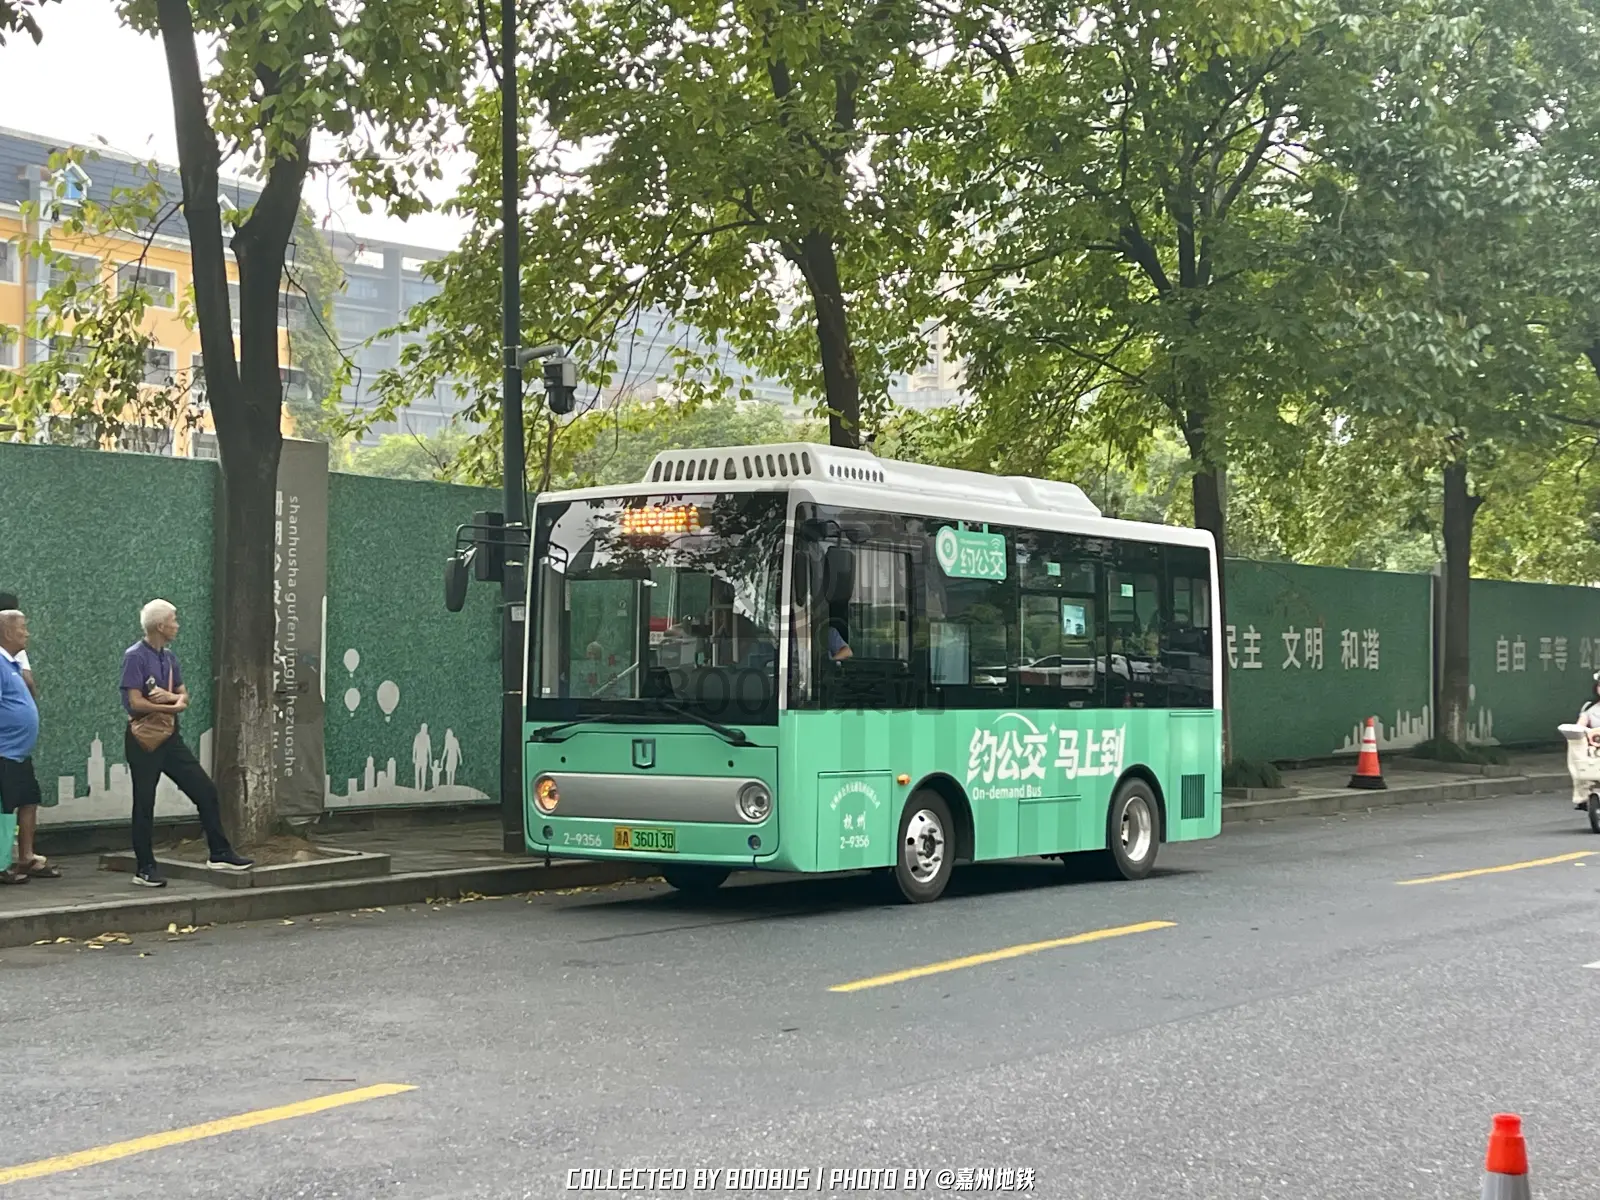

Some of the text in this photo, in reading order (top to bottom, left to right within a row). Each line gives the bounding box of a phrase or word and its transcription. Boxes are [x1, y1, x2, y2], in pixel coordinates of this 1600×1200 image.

[286, 495, 299, 587] shanhusha
[960, 547, 1004, 576] 约公交
[285, 592, 299, 642] gufen
[1226, 624, 1380, 671] 民主 文明 和谐
[1496, 634, 1526, 672] 自由
[1539, 636, 1568, 671] 平等
[284, 695, 298, 777] hezuoshe
[966, 722, 1126, 786] 约公交 马上到
[972, 784, 1042, 800] On-demand Bus
[563, 832, 602, 847] 2-9356
[633, 831, 674, 849] 36013D
[840, 834, 870, 849] 2-9356
